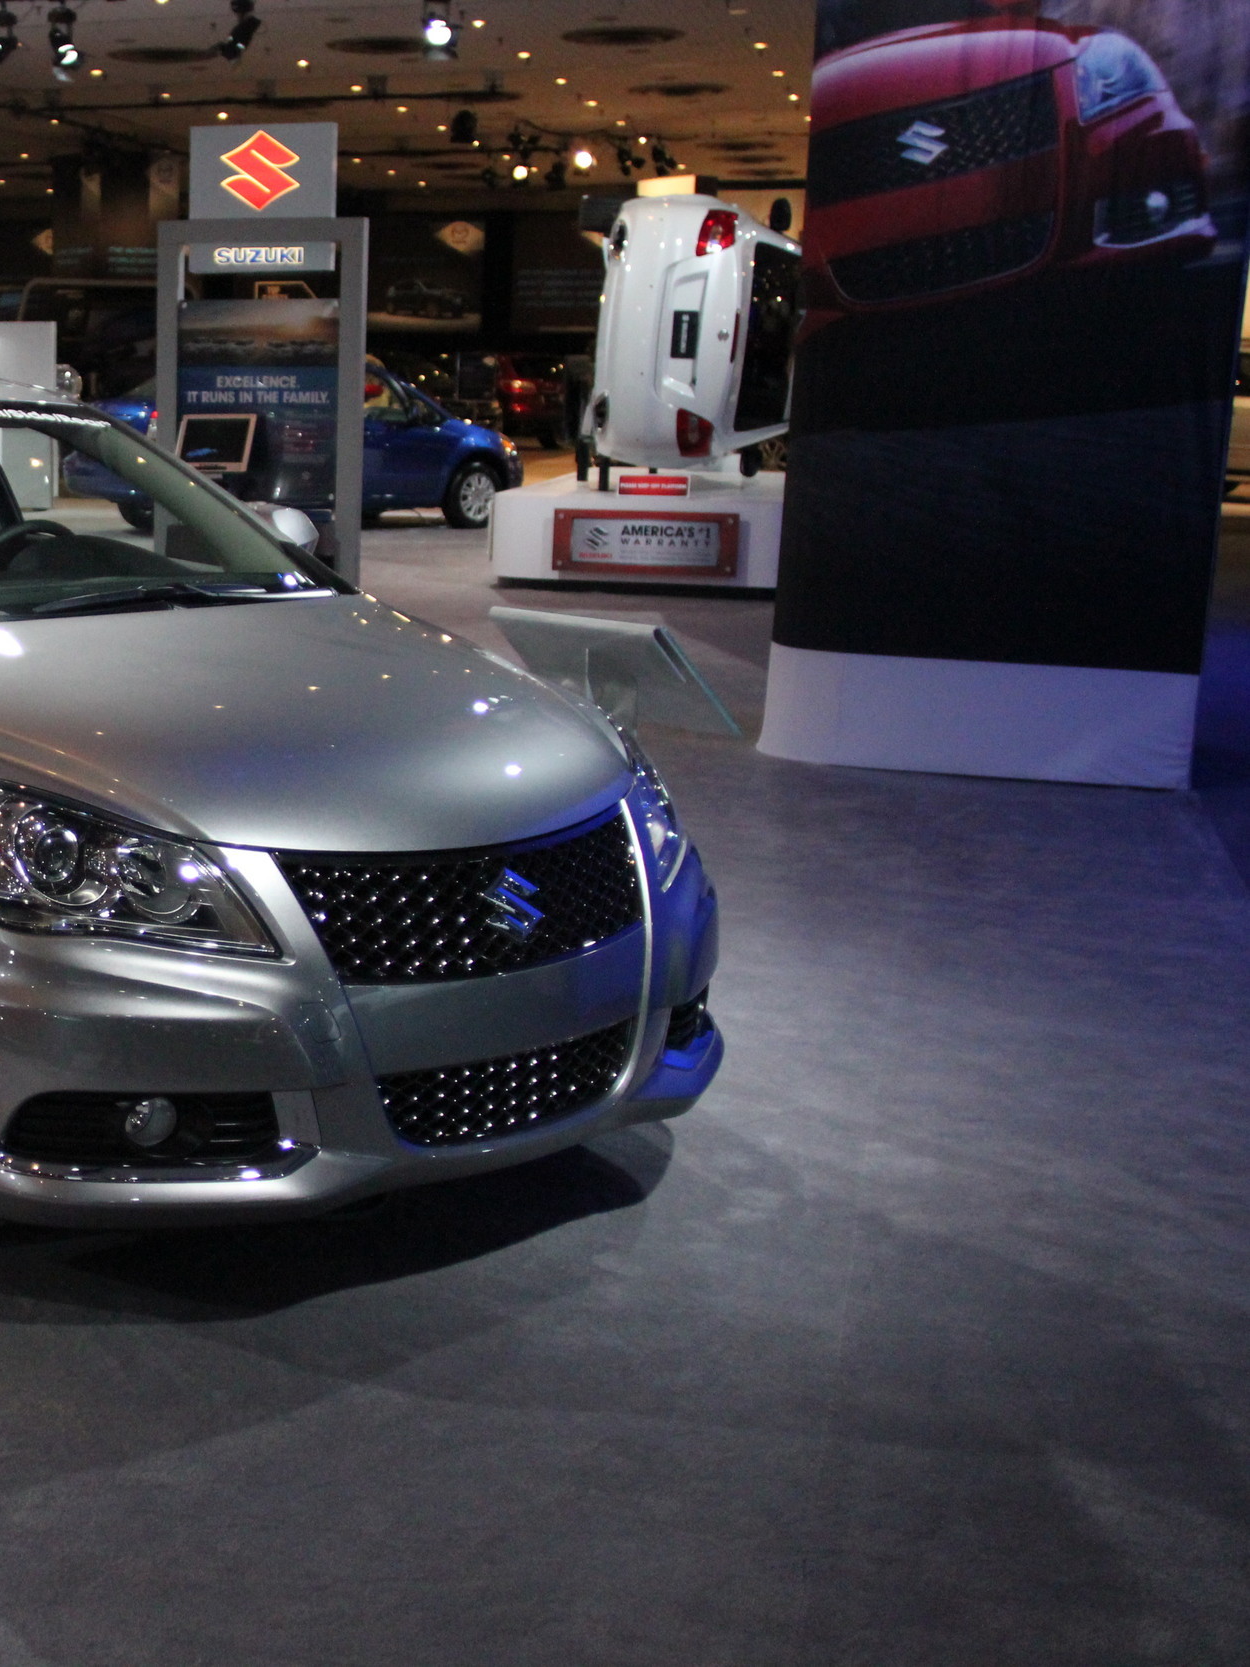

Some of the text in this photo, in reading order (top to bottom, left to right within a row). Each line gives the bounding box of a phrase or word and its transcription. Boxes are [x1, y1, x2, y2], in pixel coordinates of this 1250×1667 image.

[213, 246, 305, 264] SUZUKI
[216, 375, 300, 389] EXCELLENCE.
[187, 390, 330, 404] IT RUNS IN THE FAMILY.
[621, 524, 695, 539] AMERICA'S
[621, 538, 711, 548] WARRANTY
